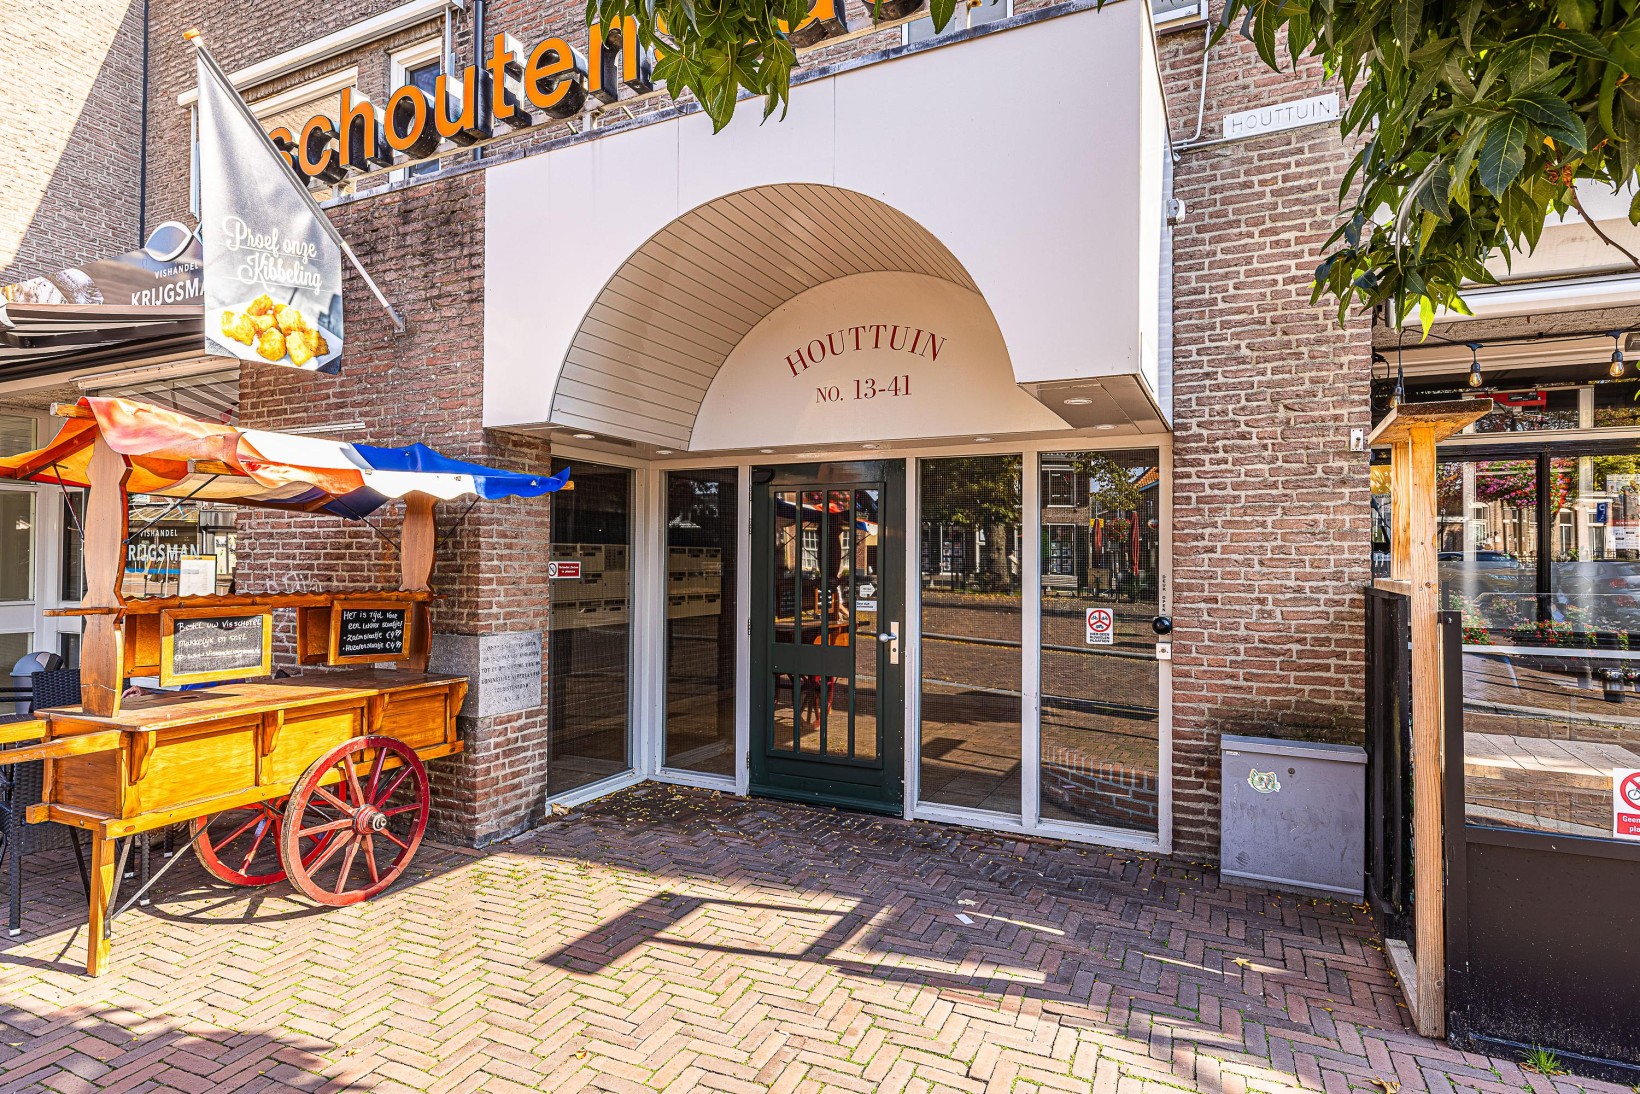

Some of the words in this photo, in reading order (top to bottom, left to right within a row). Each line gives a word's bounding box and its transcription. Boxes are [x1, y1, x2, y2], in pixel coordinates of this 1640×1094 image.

[1232, 101, 1331, 133] HOUTTUIN
[222, 216, 280, 257] Proef
[284, 239, 317, 263] onze
[154, 262, 199, 279] VISHANDEL
[238, 251, 322, 295] Kibbeling
[784, 324, 948, 378] HOUTTUIN
[815, 385, 844, 403] NO.
[853, 374, 912, 401] 13-41
[140, 528, 178, 537] VISHANDEL
[128, 543, 200, 562] RIJGSMAN
